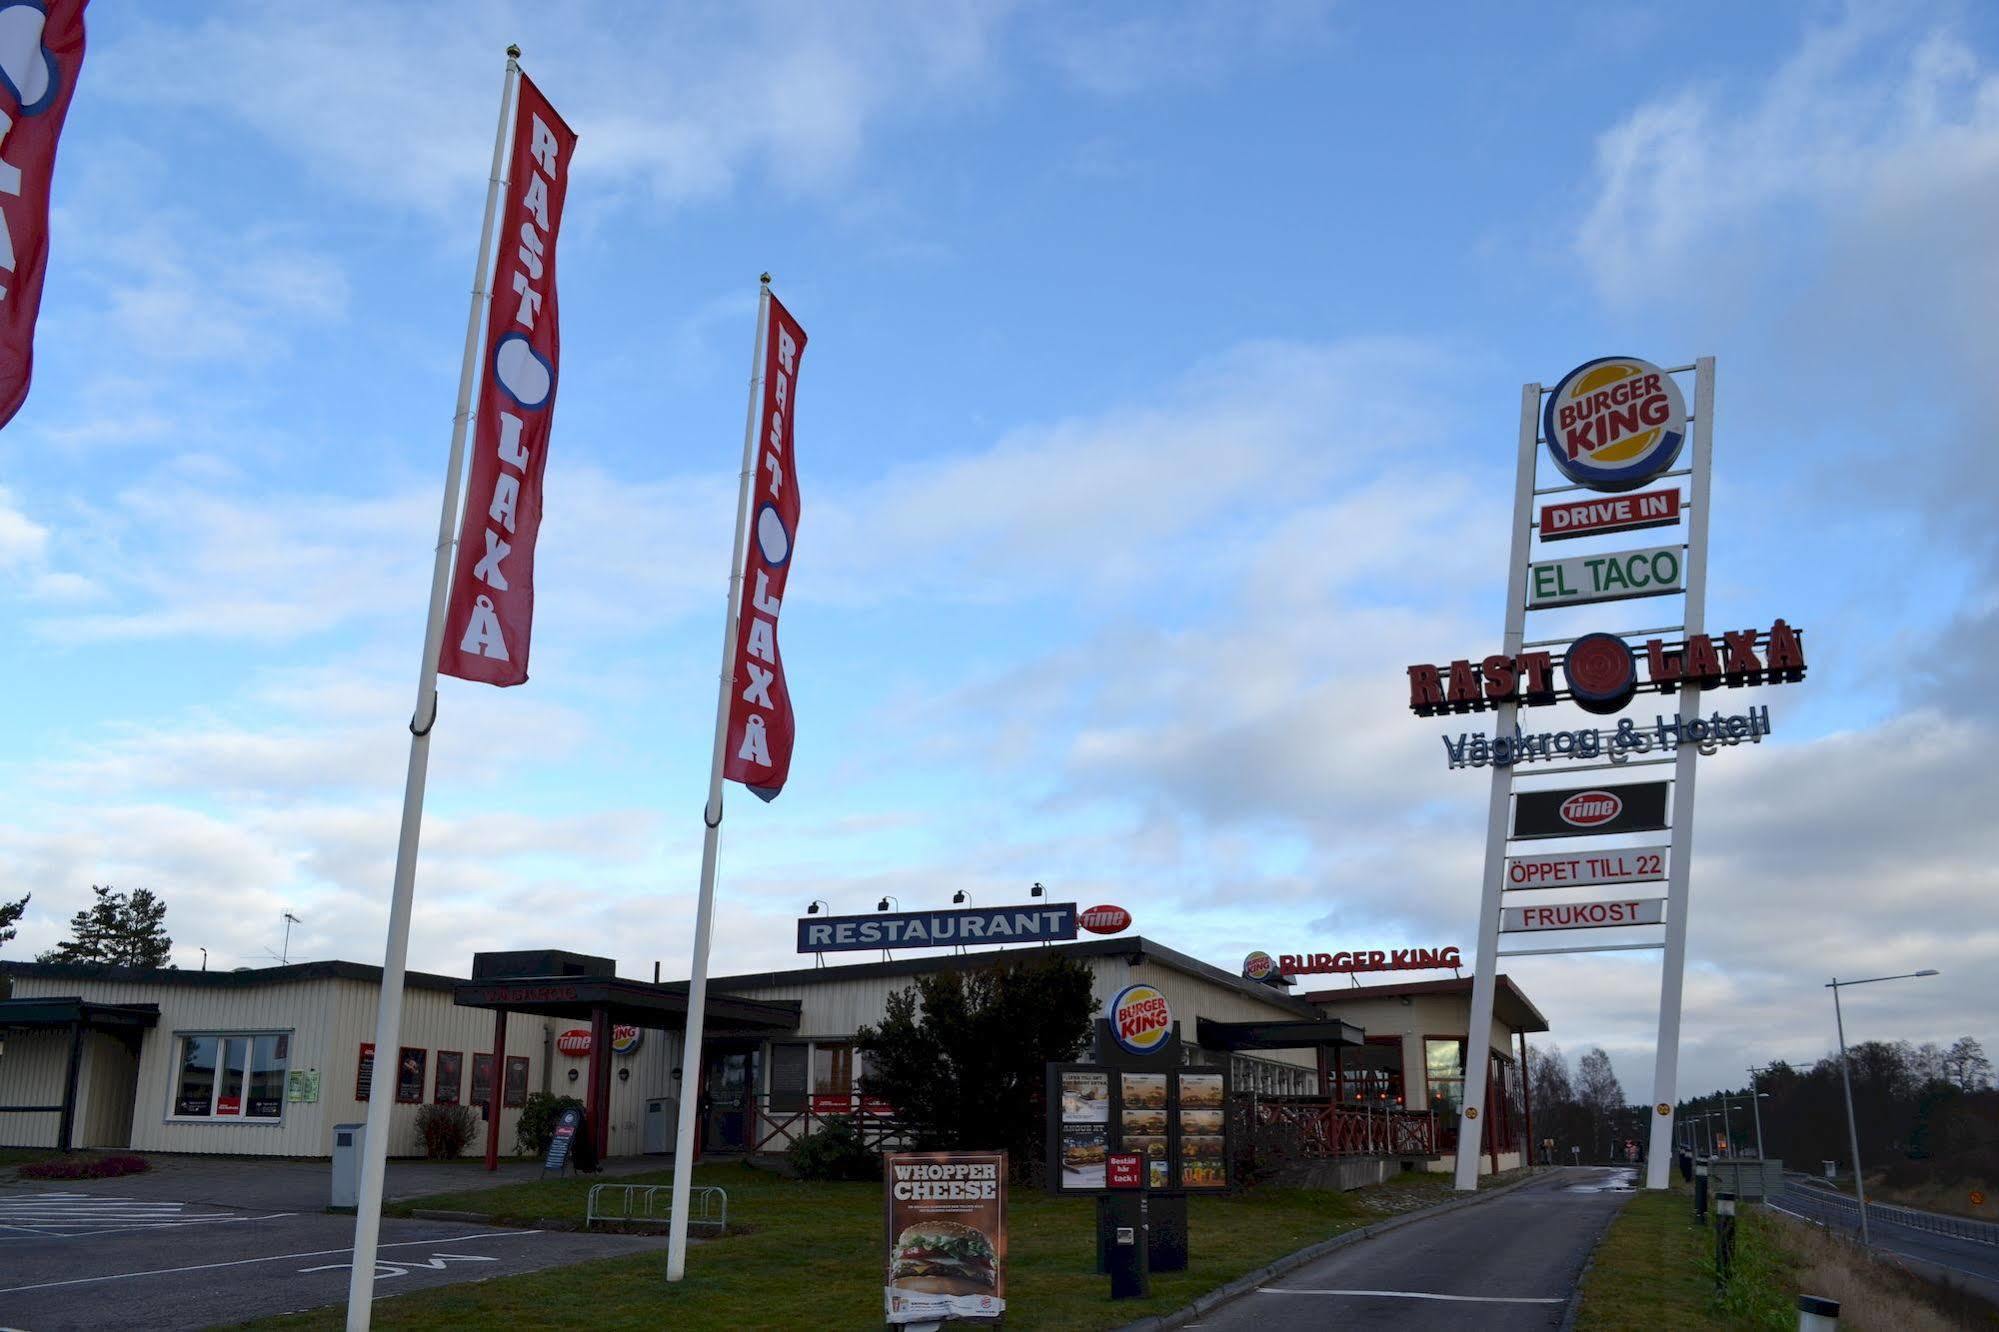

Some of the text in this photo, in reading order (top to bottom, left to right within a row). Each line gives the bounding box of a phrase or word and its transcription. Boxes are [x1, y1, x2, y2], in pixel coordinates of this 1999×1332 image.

[513, 112, 558, 331] RAST
[1559, 373, 1662, 431] BURGER
[1565, 394, 1669, 461] KING
[1552, 495, 1669, 528] DRIVE IN
[460, 411, 529, 661] LAXÅ
[1534, 551, 1678, 598] EL TACO
[738, 568, 781, 767] LAXÅ
[1408, 618, 1803, 707] RAST LAXÅ
[1443, 705, 1770, 767] Vägkrog & Hotell
[1563, 798, 1615, 819] Time
[1510, 855, 1661, 884] ÖPPET TILL 22
[808, 911, 1068, 945] RESTAURANT
[1523, 903, 1640, 927] FRUKOST
[1279, 946, 1461, 976] BURGER KING
[1118, 998, 1166, 1023] BURGER
[1121, 1009, 1168, 1040] KING
[613, 1027, 636, 1040] ING
[894, 1164, 996, 1181] WHOPPER
[1114, 1174, 1133, 1183] tack
[893, 1180, 996, 1200] CHEESE
